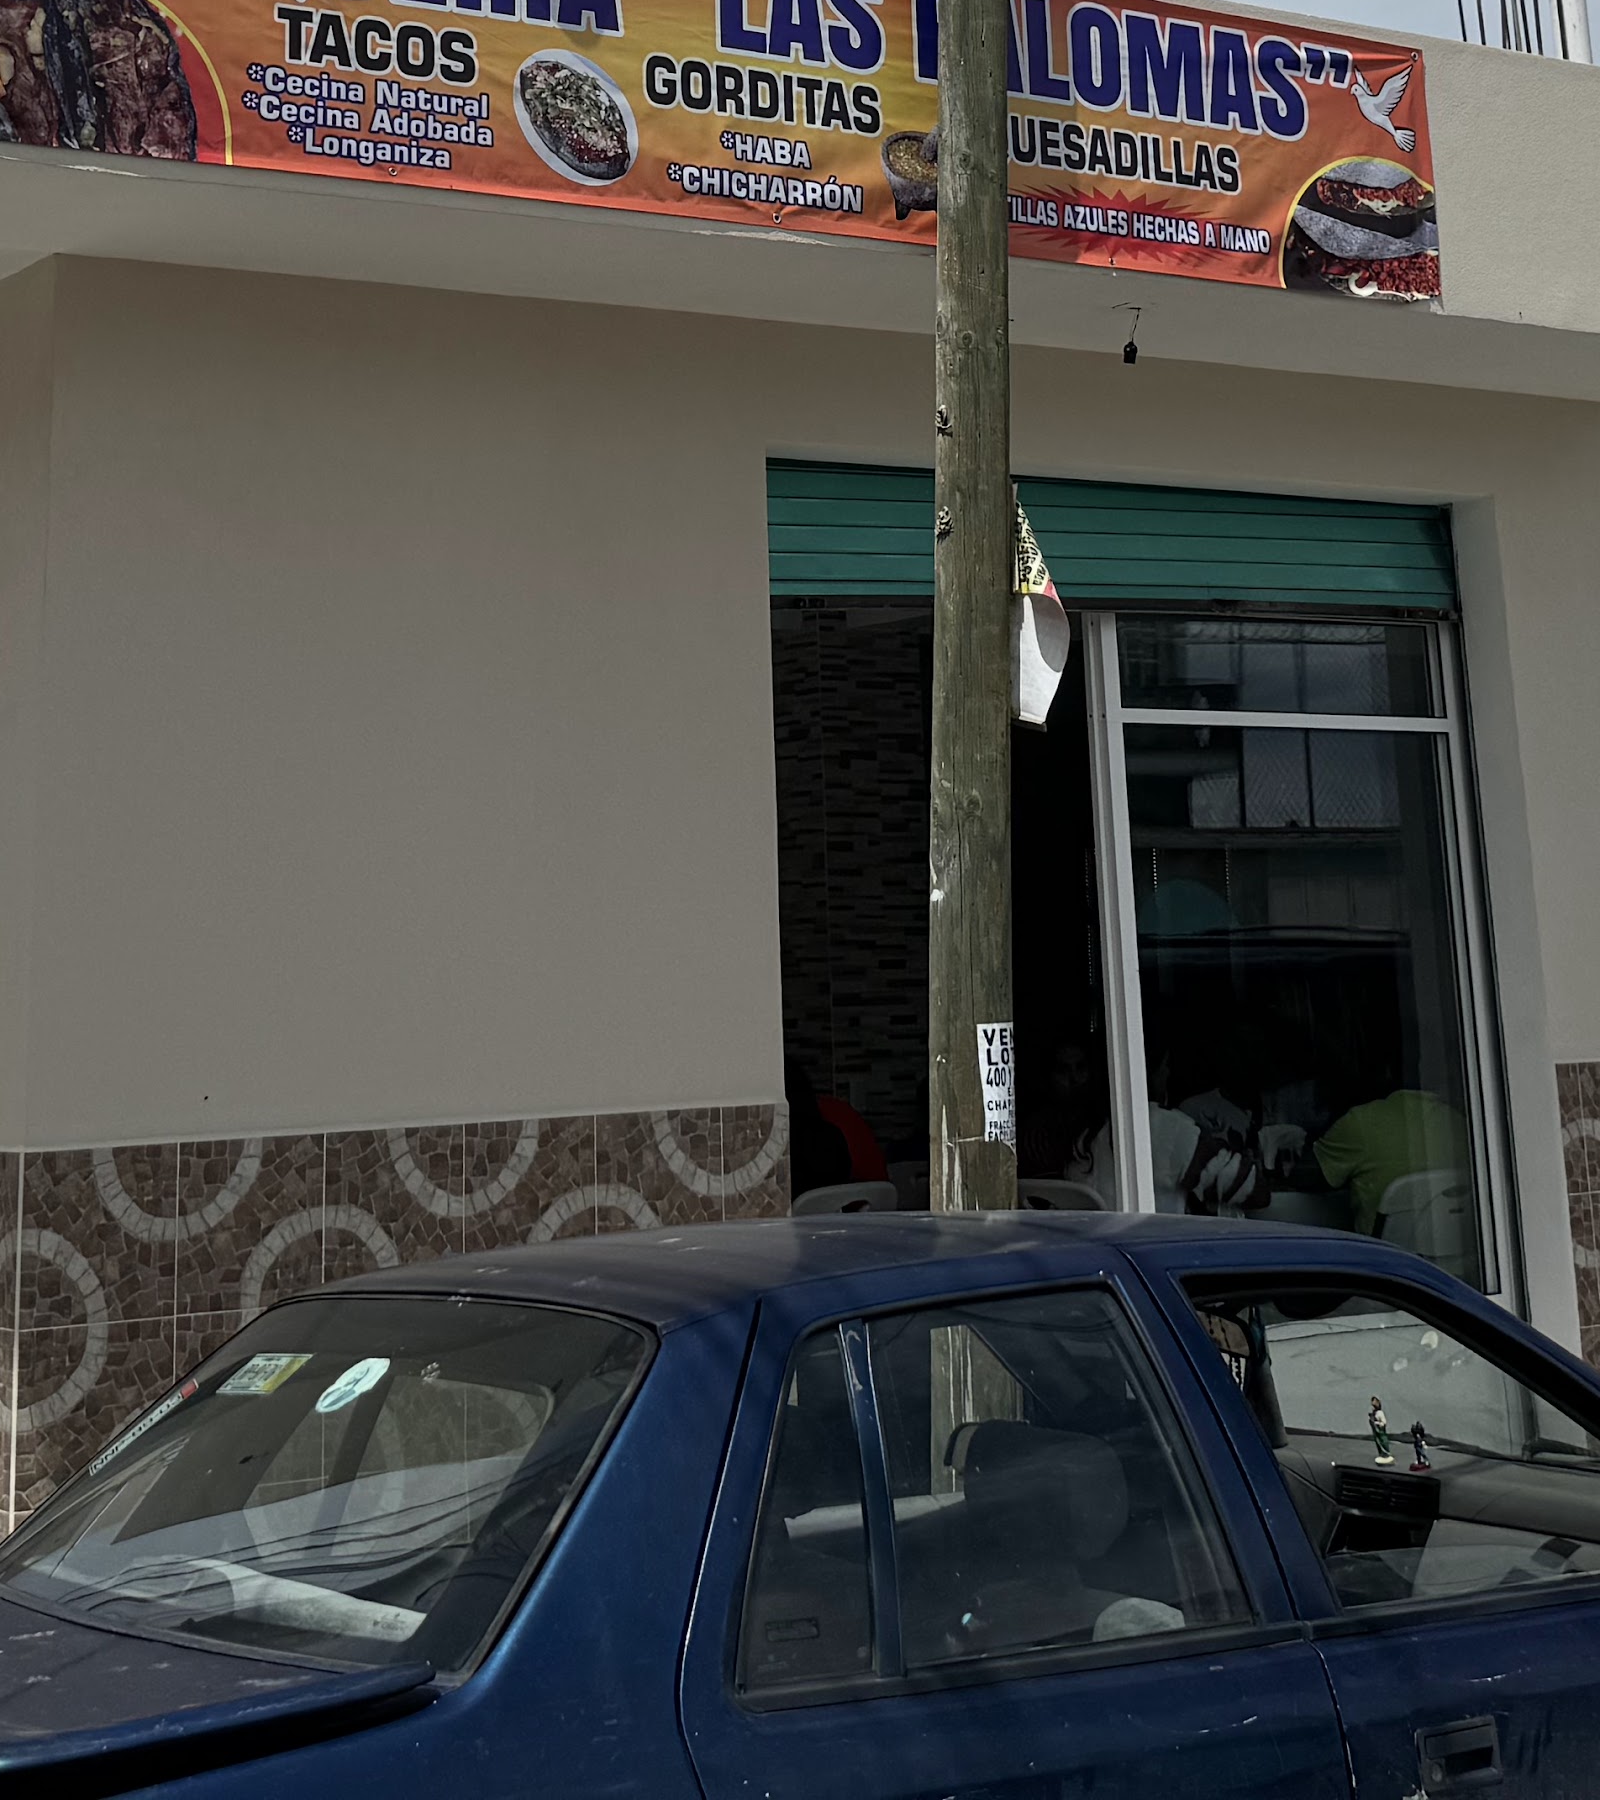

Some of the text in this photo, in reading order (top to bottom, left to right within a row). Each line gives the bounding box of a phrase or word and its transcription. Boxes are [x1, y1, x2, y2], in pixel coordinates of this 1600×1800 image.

[274, 6, 478, 86] TACOS
[376, 79, 490, 119] Natural
[644, 55, 882, 135] GORDITAS
[370, 110, 493, 149] Adobada
[1007, 110, 1241, 196] UESADILLAS
[1062, 203, 1128, 236] AZULES
[1132, 212, 1203, 247] HECHAS
[1204, 223, 1219, 249] A
[1220, 226, 1271, 255] MANO
